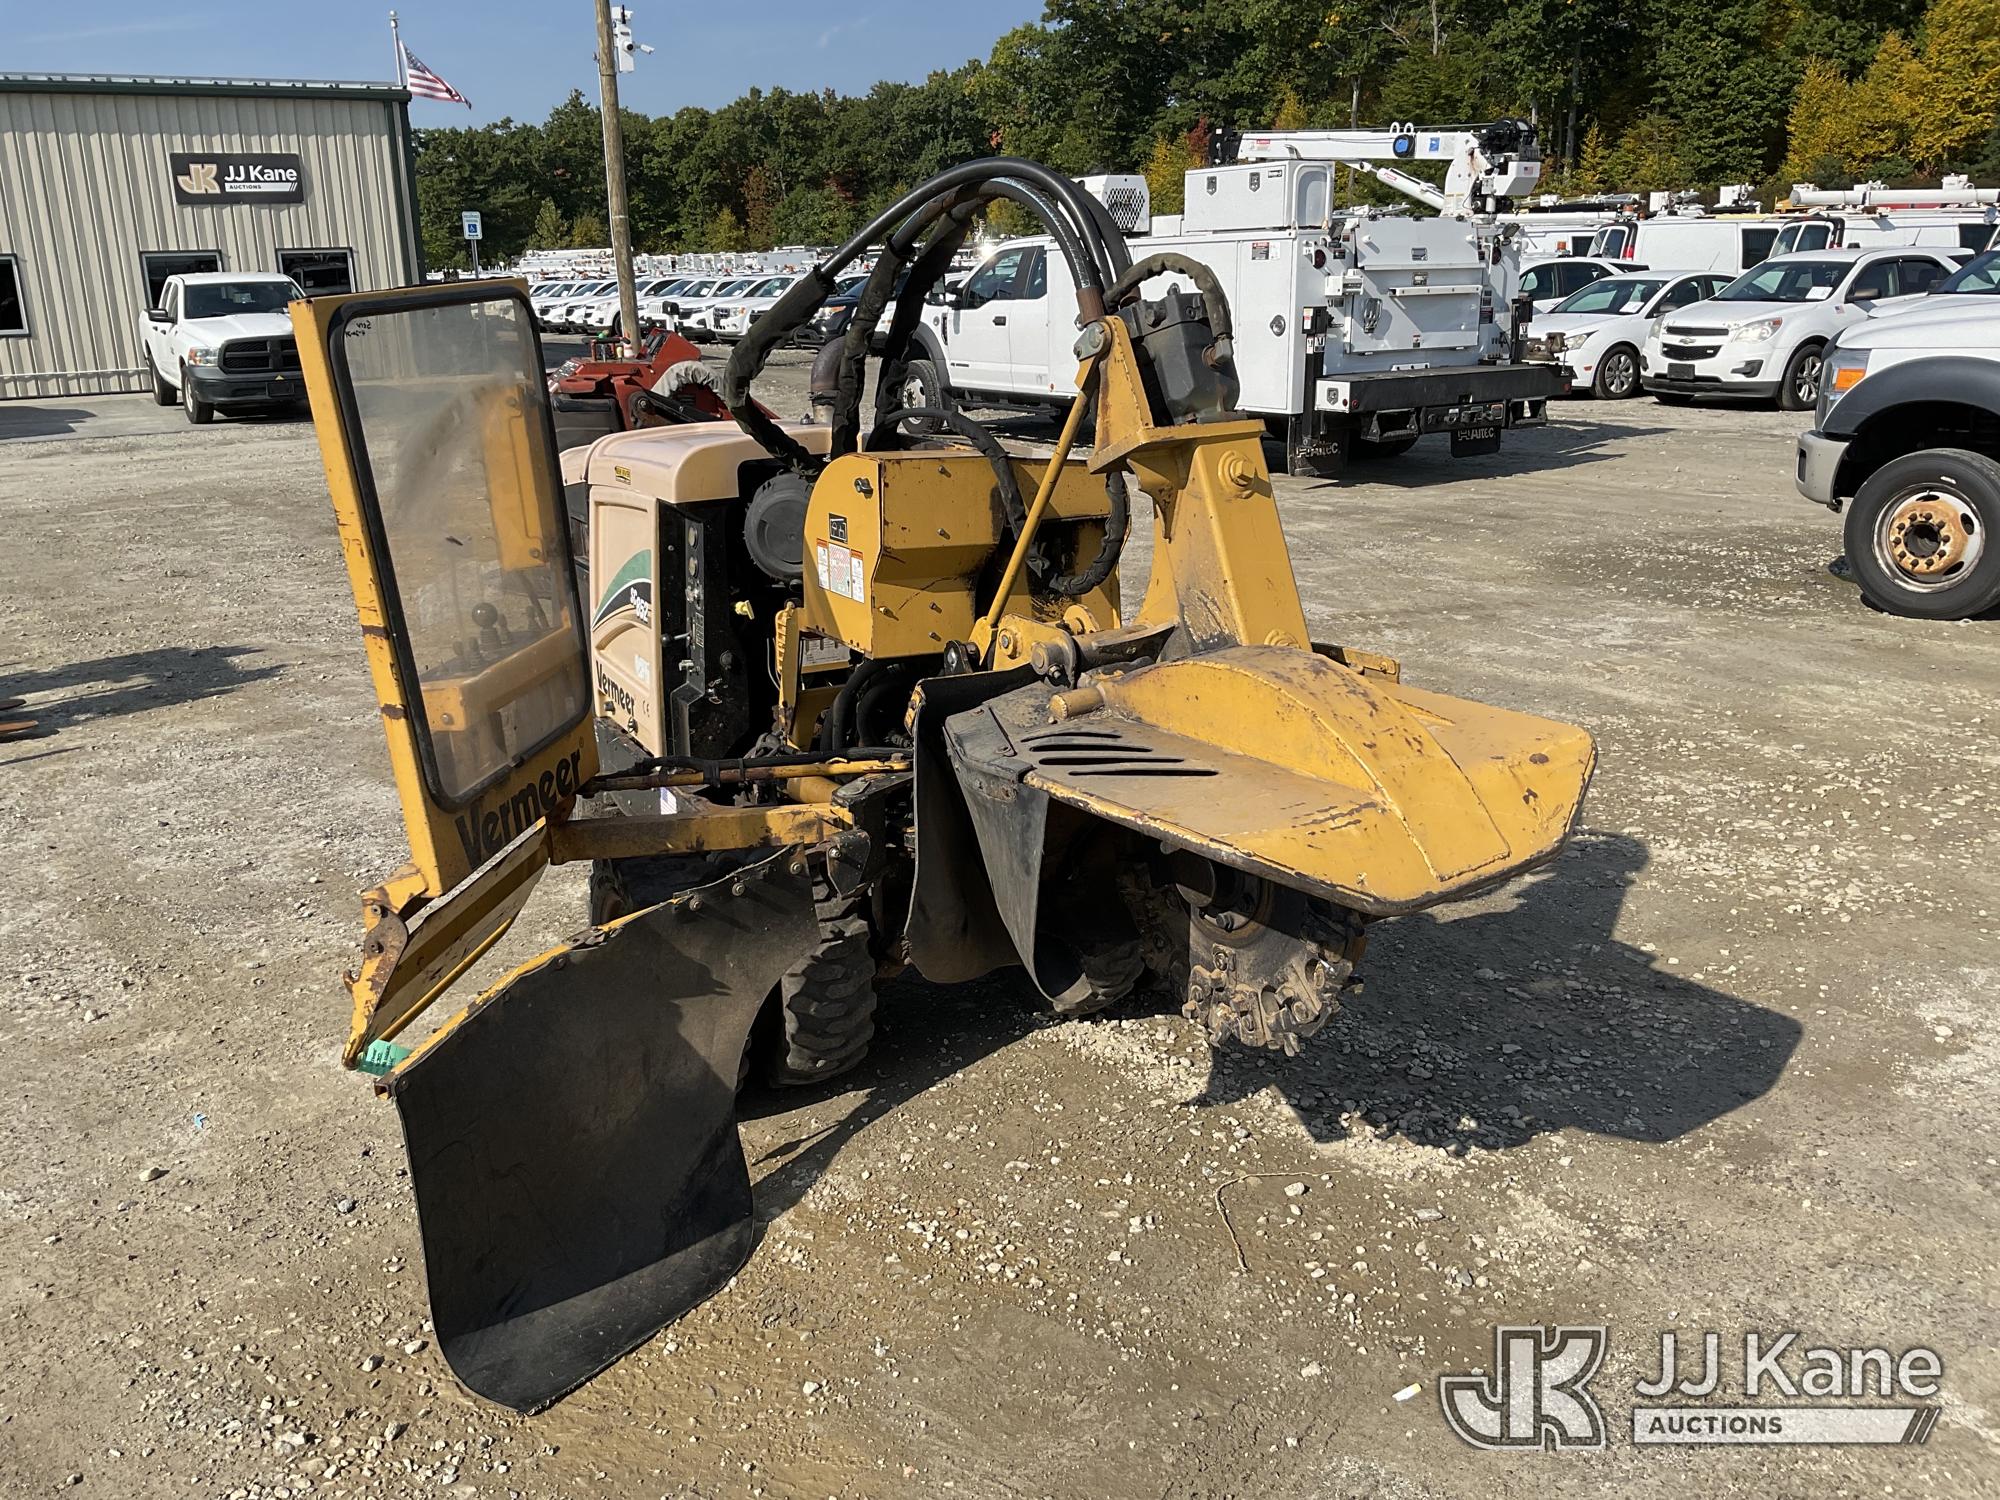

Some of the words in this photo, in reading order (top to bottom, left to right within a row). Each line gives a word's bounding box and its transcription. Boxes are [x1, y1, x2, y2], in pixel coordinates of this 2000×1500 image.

[224, 165, 246, 181] JJ
[249, 165, 297, 181] Kane
[596, 660, 635, 717] Vermeer
[455, 749, 580, 870] Vermeer
